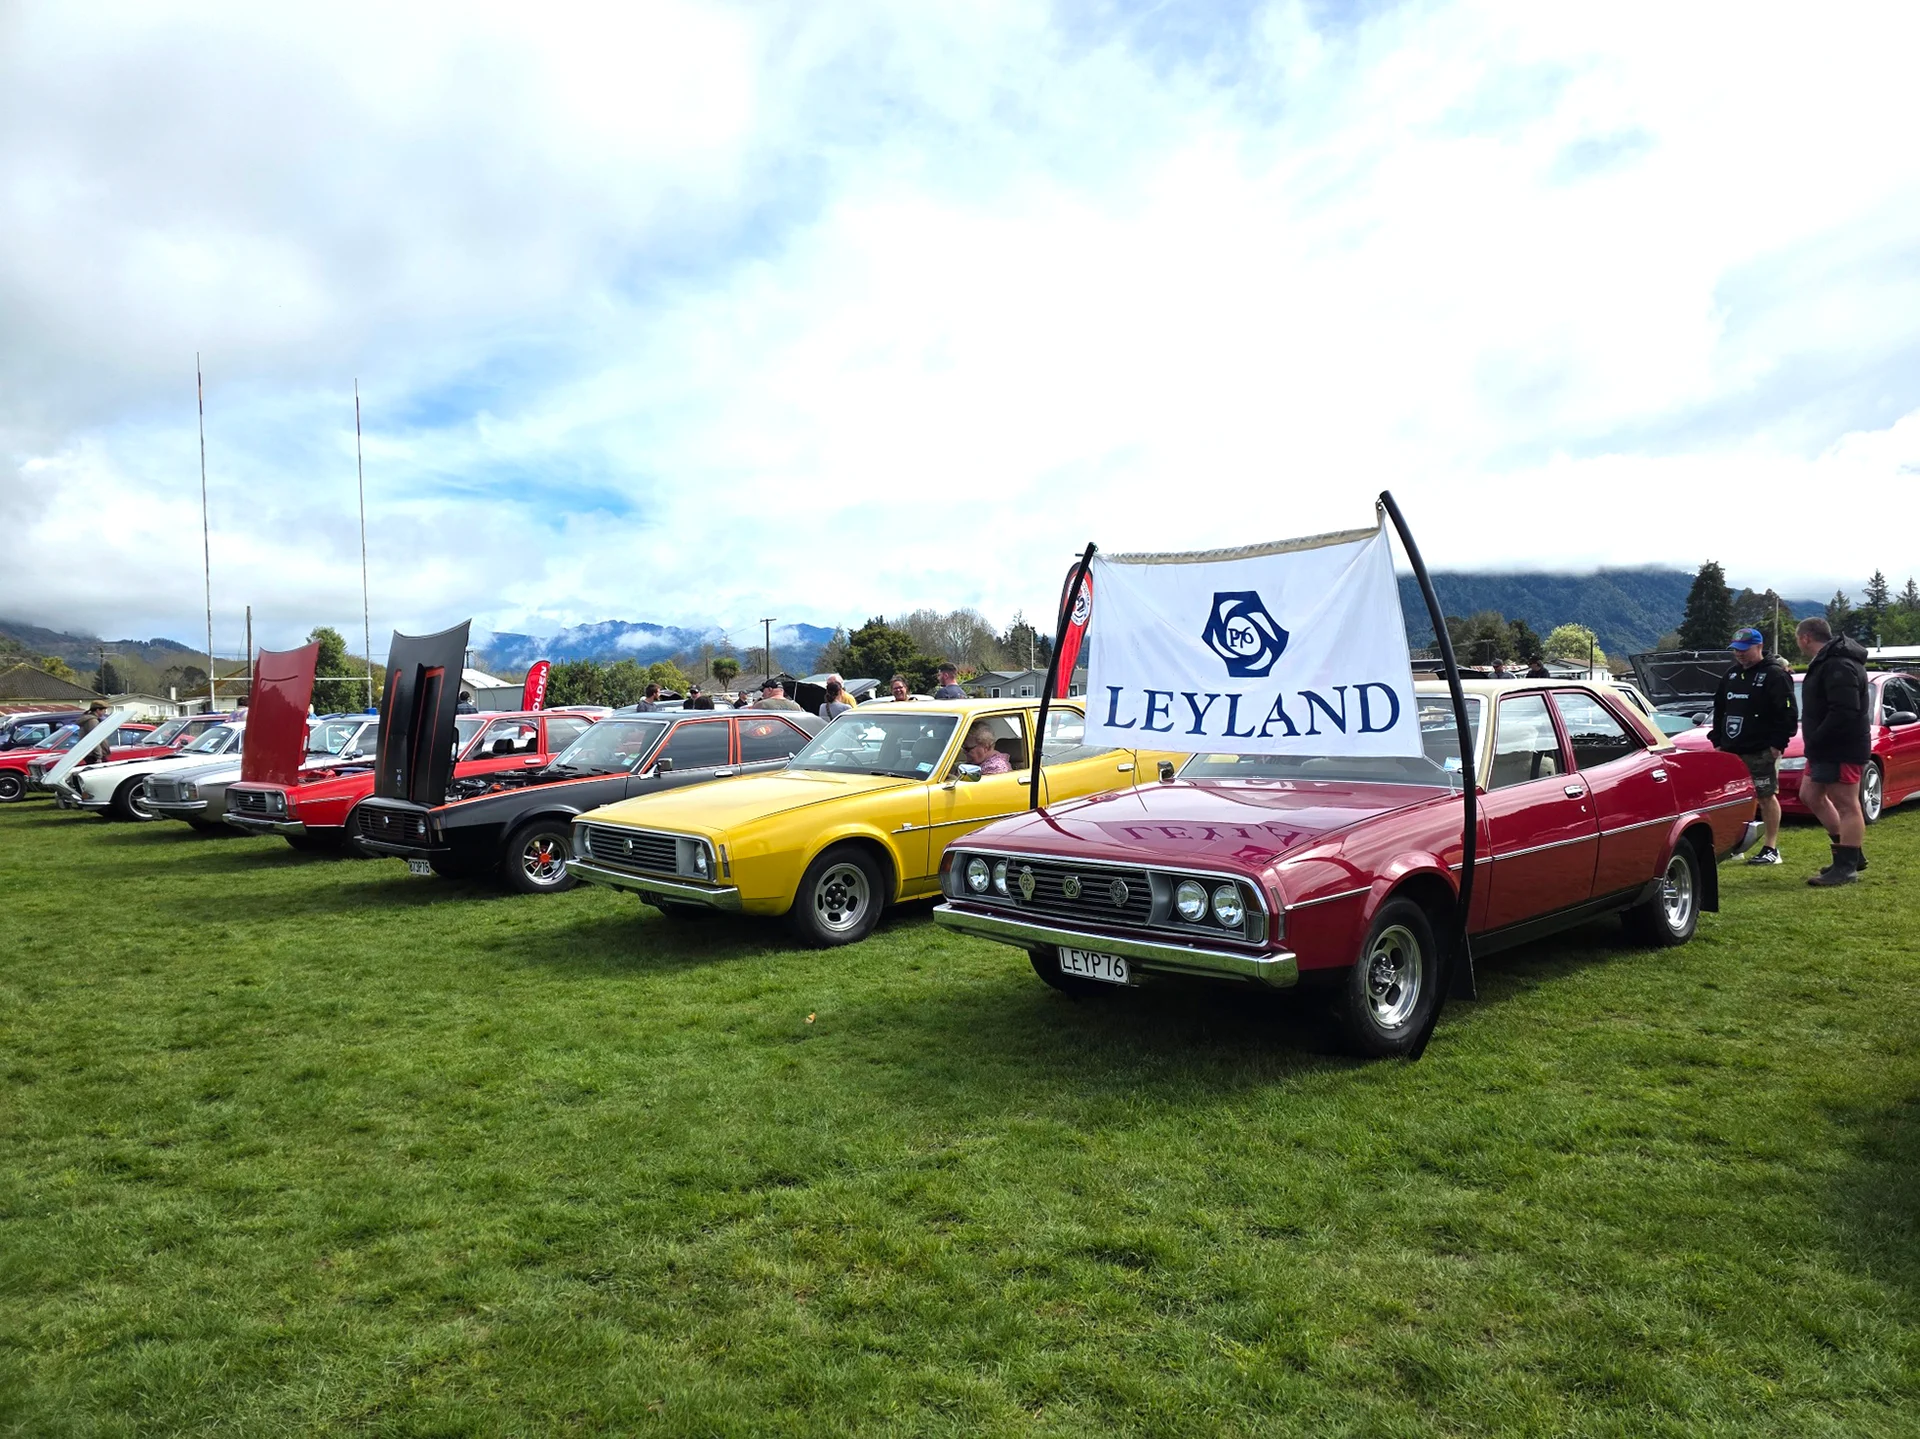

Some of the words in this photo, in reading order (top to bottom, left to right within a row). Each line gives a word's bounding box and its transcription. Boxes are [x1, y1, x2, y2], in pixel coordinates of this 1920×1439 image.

[1228, 626, 1254, 648] P76
[532, 665, 547, 711] OLDEN
[1103, 682, 1401, 738] LEYLAND
[1060, 948, 1124, 978] LEYP76
